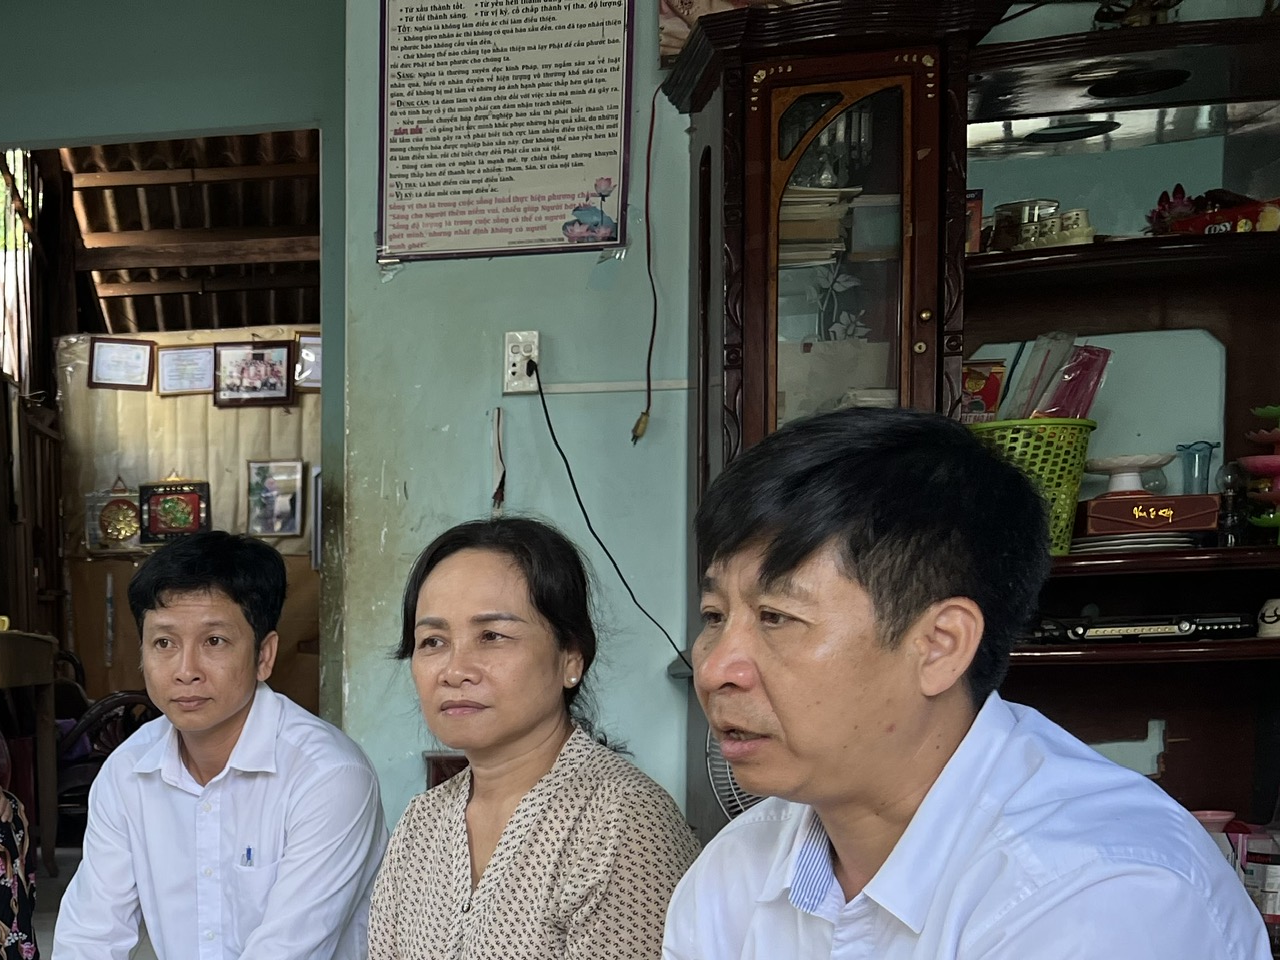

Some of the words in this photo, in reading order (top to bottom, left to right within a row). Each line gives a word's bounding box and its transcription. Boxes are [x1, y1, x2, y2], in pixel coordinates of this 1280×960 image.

[405, 5, 414, 13] Từ
[416, 3, 429, 12] xấu
[430, 2, 451, 11] thành
[480, 8, 489, 16] Từ
[491, 8, 498, 18] vị
[512, 5, 520, 14] cố
[521, 4, 539, 15] chấp
[541, 3, 562, 12] thành
[564, 2, 571, 12] vị
[588, 0, 598, 10] độ
[405, 14, 414, 22] Từ
[416, 12, 425, 21] tối
[427, 12, 448, 20] thành
